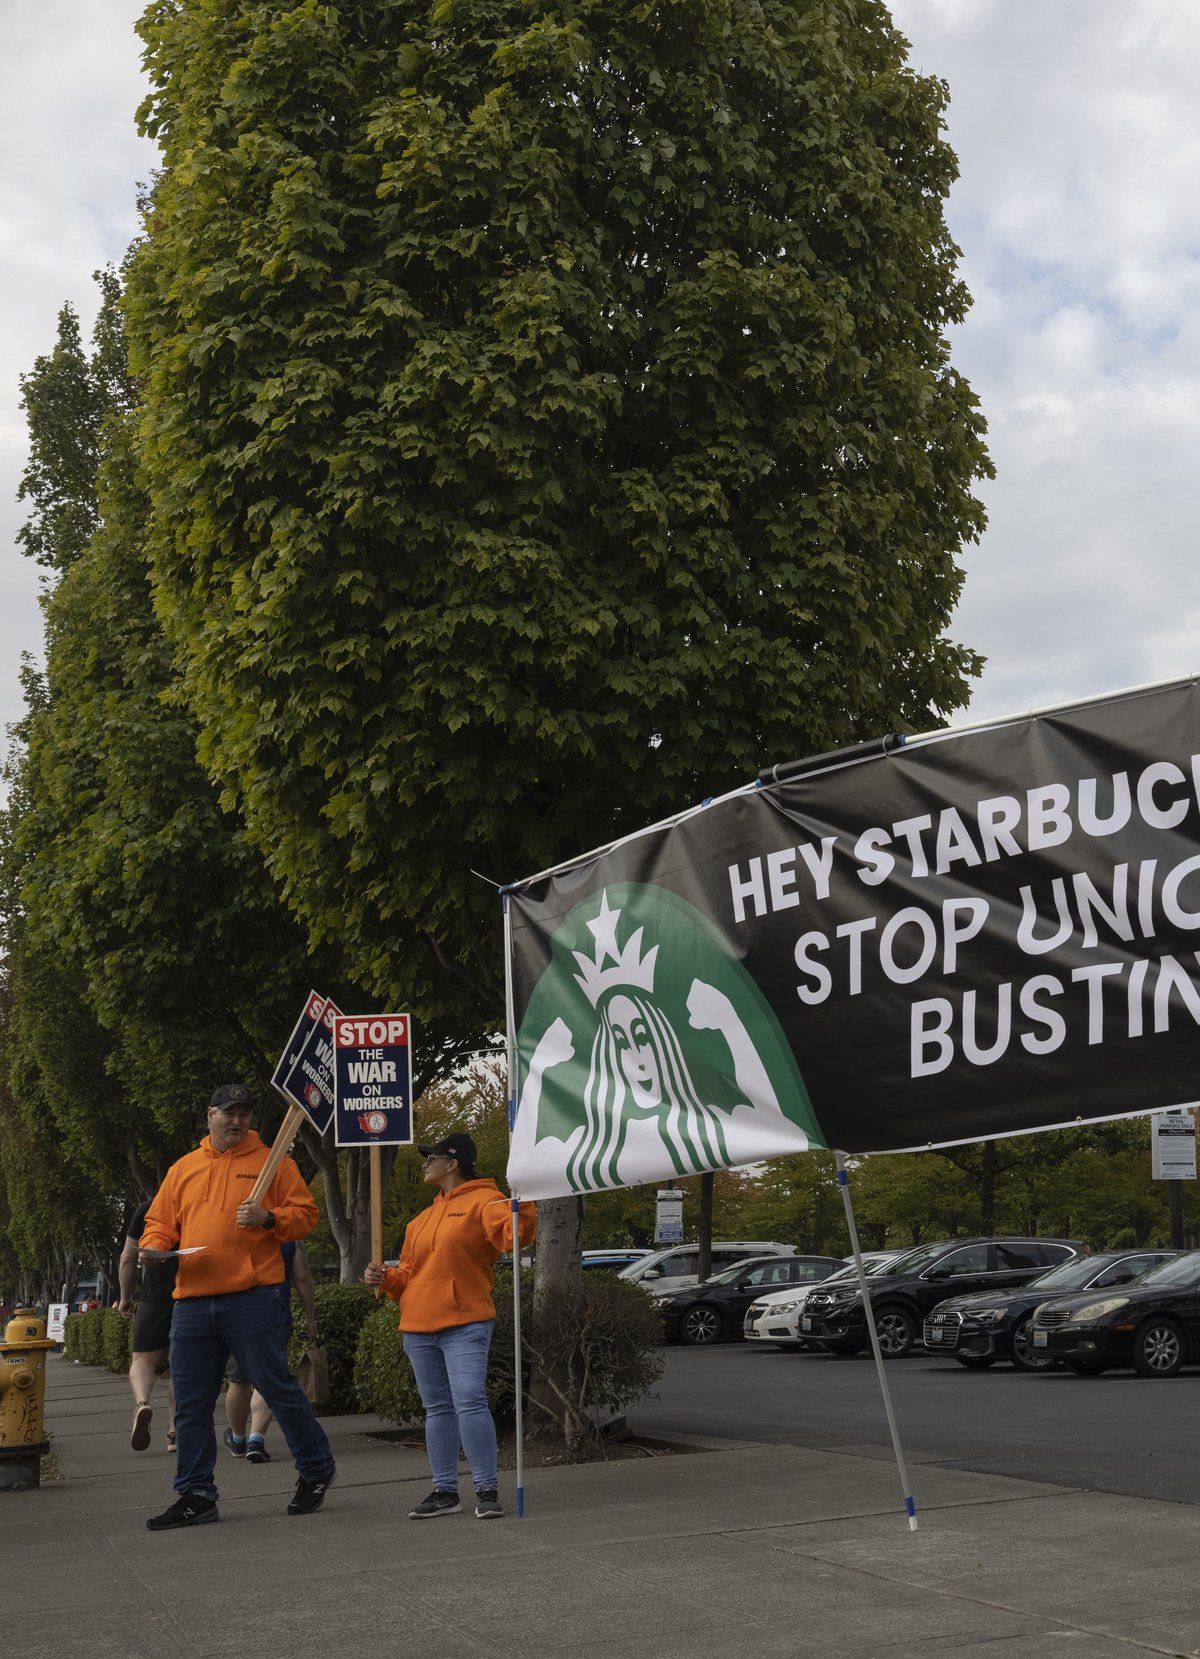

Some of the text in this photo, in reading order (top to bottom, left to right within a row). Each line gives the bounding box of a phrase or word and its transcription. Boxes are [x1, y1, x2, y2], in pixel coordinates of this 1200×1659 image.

[728, 836, 837, 923] HEY
[794, 896, 990, 1005] STOP
[339, 1020, 404, 1046] STOP
[314, 1038, 335, 1075] WA
[358, 1049, 384, 1060] THE
[301, 1059, 334, 1105] WORKERS
[318, 1065, 331, 1082] ON
[347, 1061, 397, 1084] WAR
[362, 1085, 381, 1096] ON
[343, 1096, 403, 1111] WORKERS
